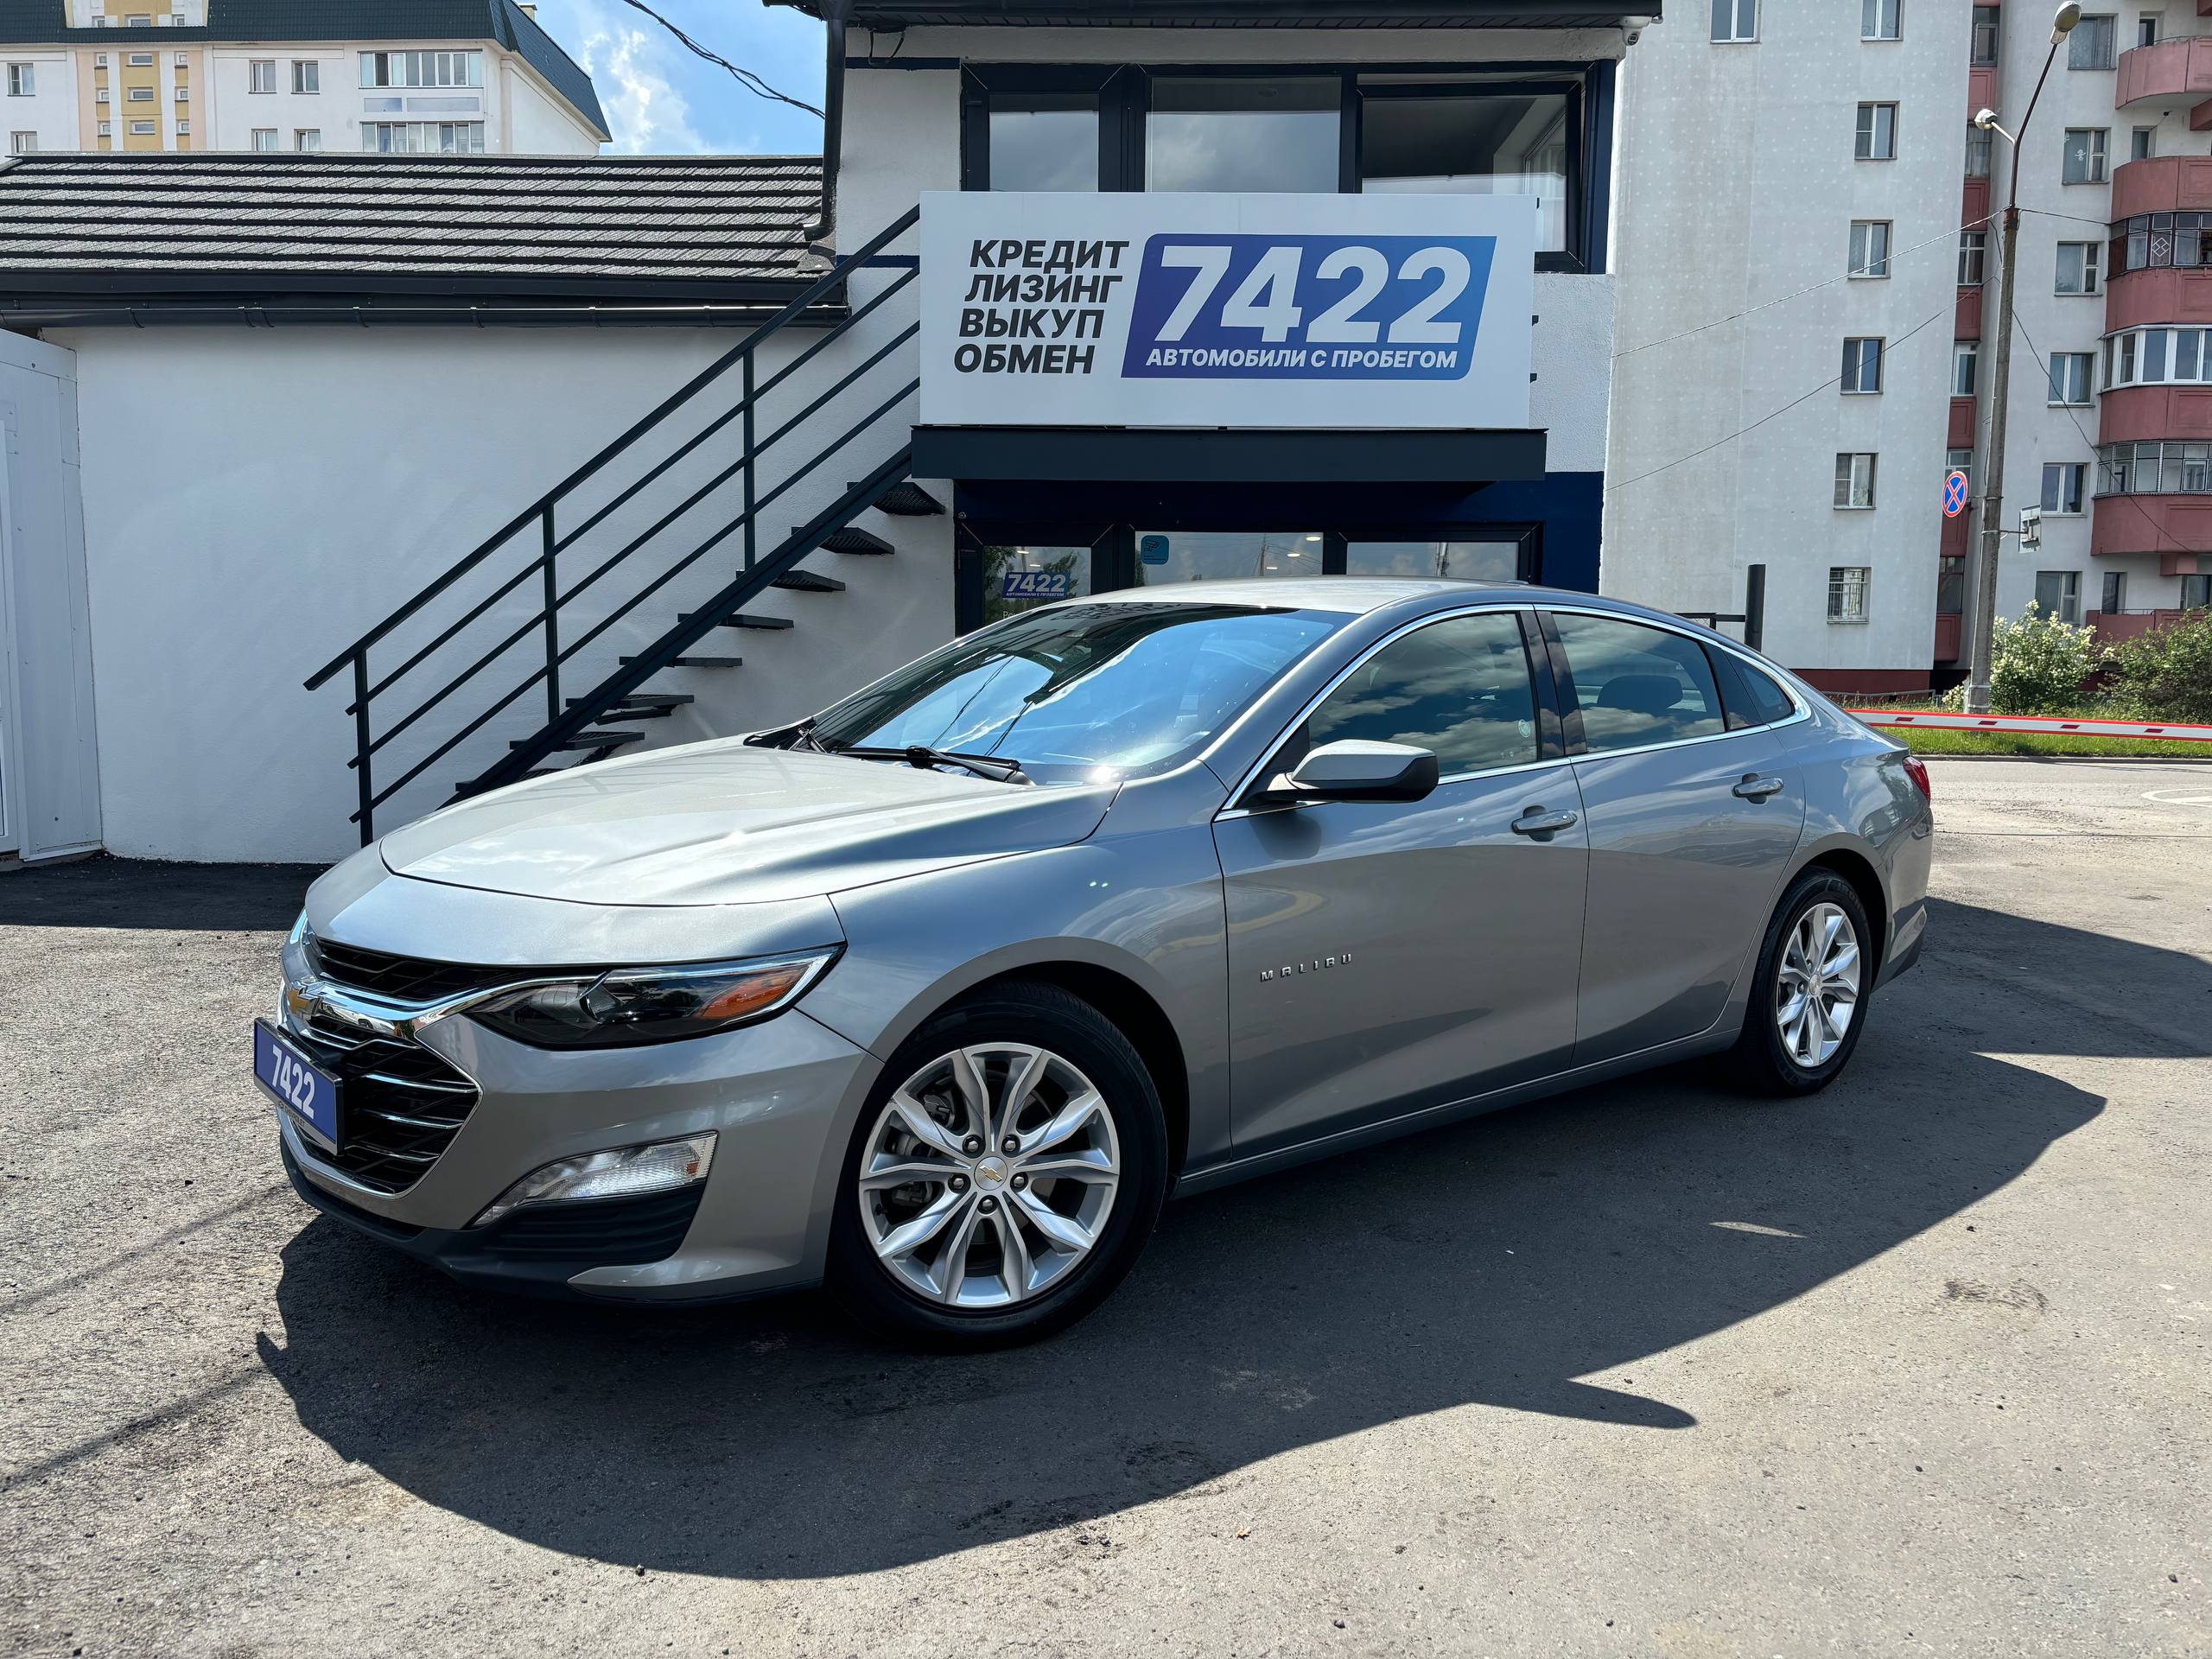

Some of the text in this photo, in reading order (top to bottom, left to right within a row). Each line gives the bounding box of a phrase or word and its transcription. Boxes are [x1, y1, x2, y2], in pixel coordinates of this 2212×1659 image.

[969, 239, 1129, 274] КРЕДИТ
[964, 274, 1123, 303] ЛИЗИНГ
[1154, 245, 1471, 344] 7422
[959, 308, 1105, 339] ВЫКУП
[954, 343, 1096, 374] ОБМЕН
[1146, 348, 1458, 369] АВТОМОБИЛИ С ПРОБЕГОМ
[1007, 574, 1066, 593] 7422
[1260, 953, 1351, 982] MALIBU
[272, 1044, 315, 1120] 7422
